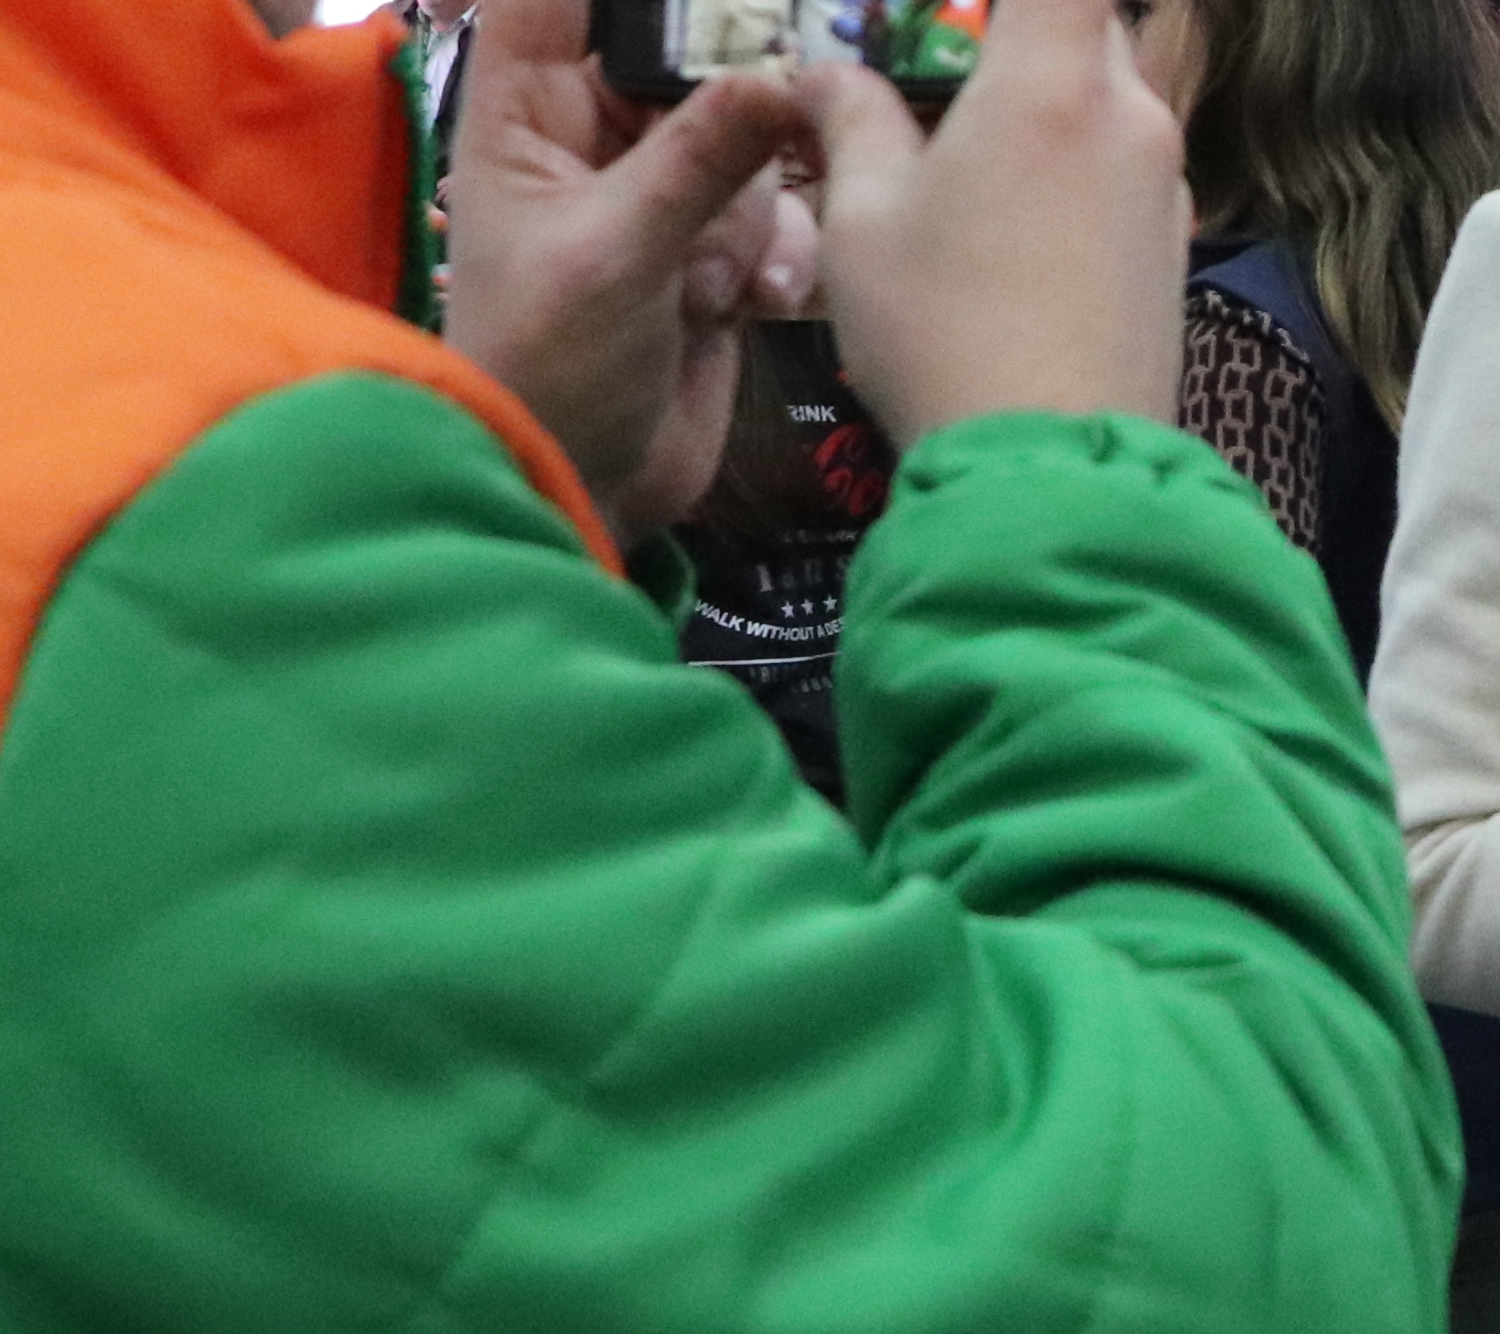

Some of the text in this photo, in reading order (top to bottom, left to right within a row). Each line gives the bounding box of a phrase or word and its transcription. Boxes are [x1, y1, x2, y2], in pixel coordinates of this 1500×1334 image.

[695, 599, 745, 632] WALK
[746, 621, 815, 642] WITHOUT
[825, 617, 847, 636] DES
